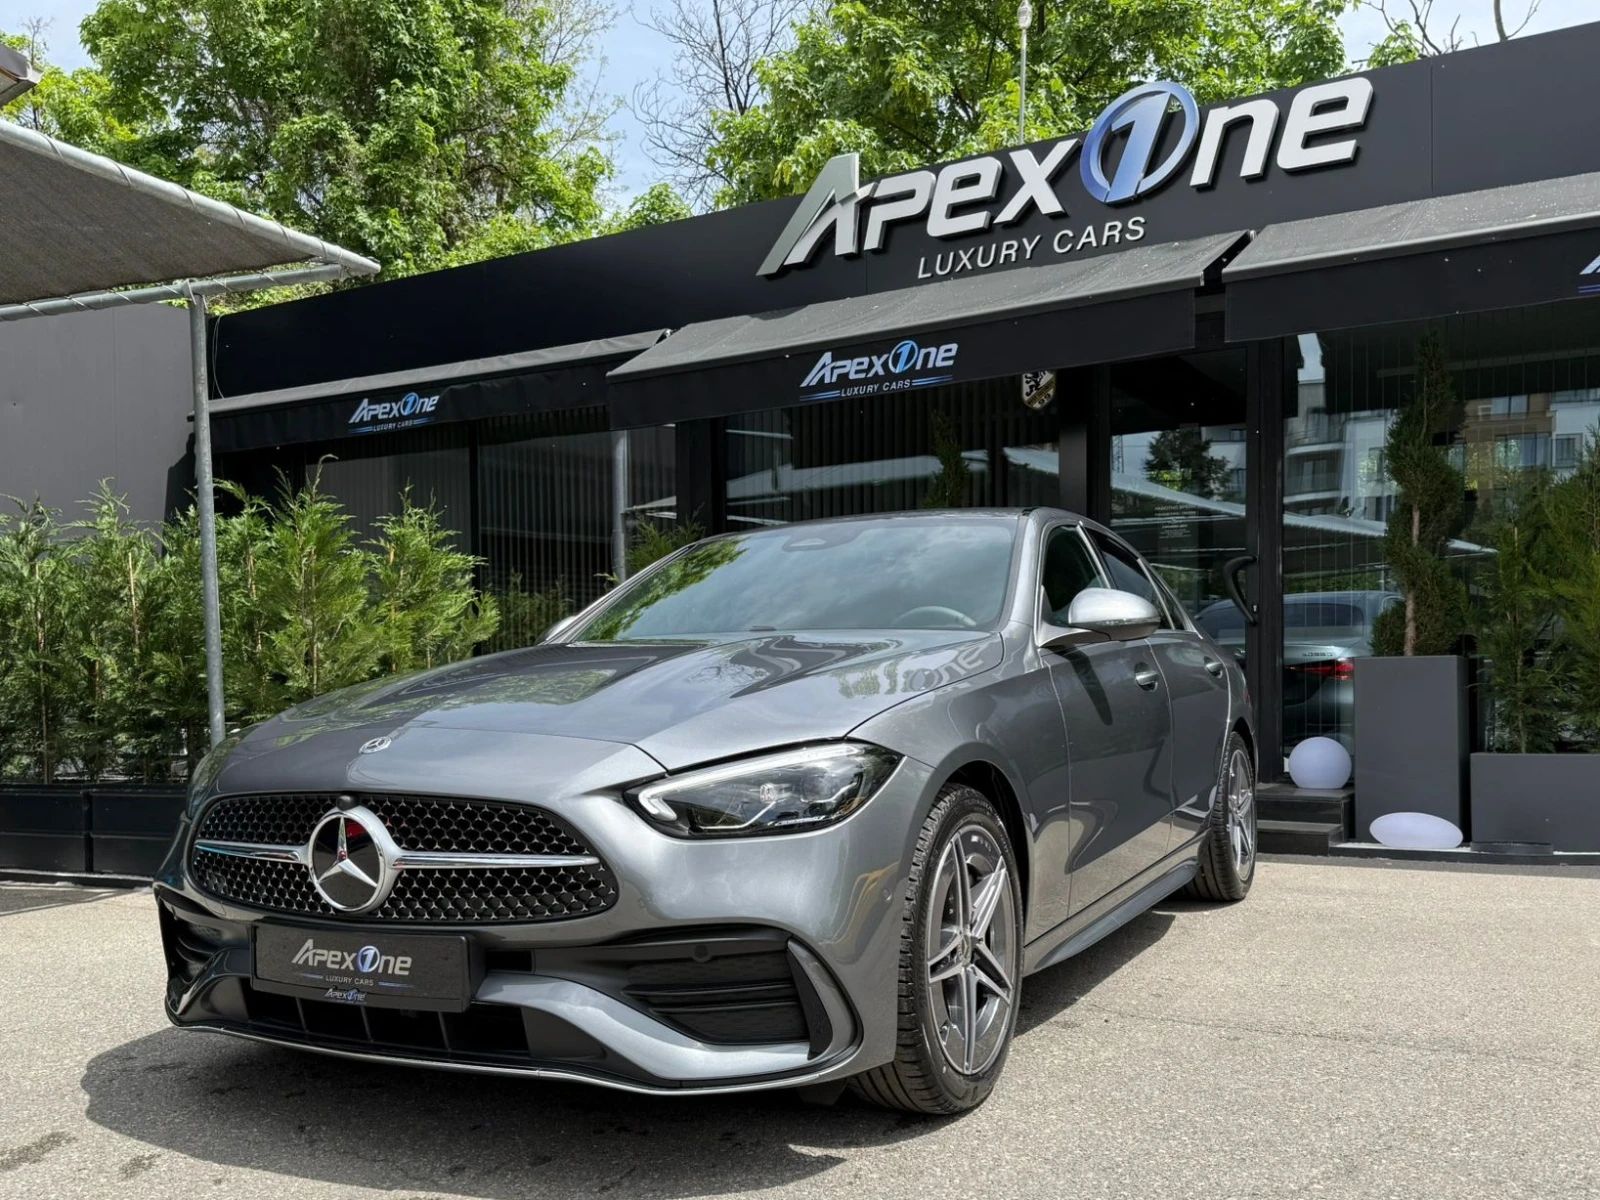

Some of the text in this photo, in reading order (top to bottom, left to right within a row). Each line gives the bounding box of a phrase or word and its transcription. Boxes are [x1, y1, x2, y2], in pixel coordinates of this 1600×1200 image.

[917, 216, 1147, 279] LUXURY CARS
[841, 379, 911, 397] LUXURY CARS
[373, 420, 413, 432] LUXURY CARS
[325, 974, 374, 987] LUXURY CARS
